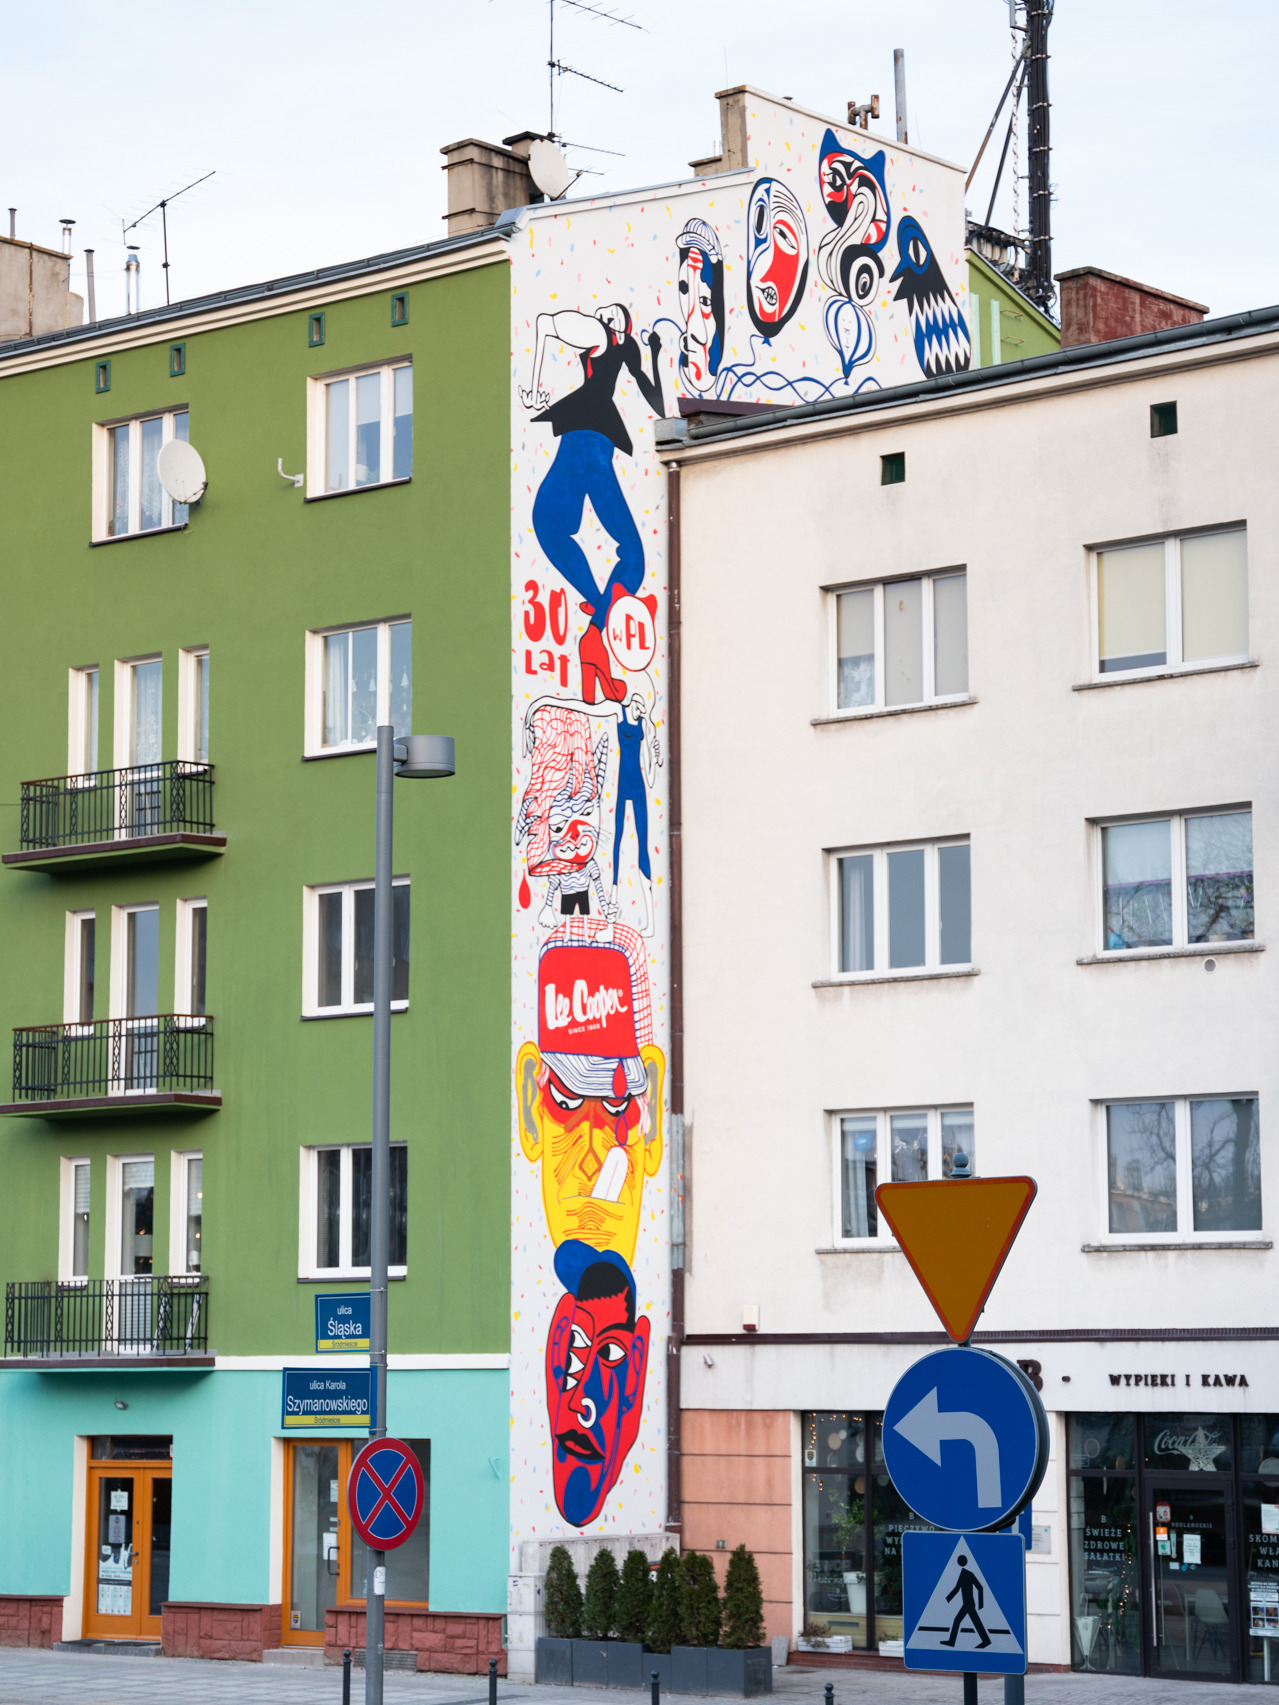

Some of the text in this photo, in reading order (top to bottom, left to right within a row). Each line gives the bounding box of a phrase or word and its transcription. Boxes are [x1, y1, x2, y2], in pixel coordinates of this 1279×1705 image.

[523, 579, 568, 645] 30
[625, 613, 651, 650] PL
[544, 983, 572, 1030] Lee
[568, 1025, 585, 1034] SINCE
[337, 1305, 352, 1315] ulica
[327, 1317, 363, 1339] Śląska
[309, 1380, 346, 1390] ulica Karola
[1108, 1374, 1249, 1387] WYPIEKI I KAWA
[286, 1395, 368, 1415] Szymanowskiego
[1085, 1527, 1122, 1537] ŚWIEŻE
[1084, 1541, 1125, 1550] ZDROWE
[1084, 1552, 1125, 1561] SAŁATKI
